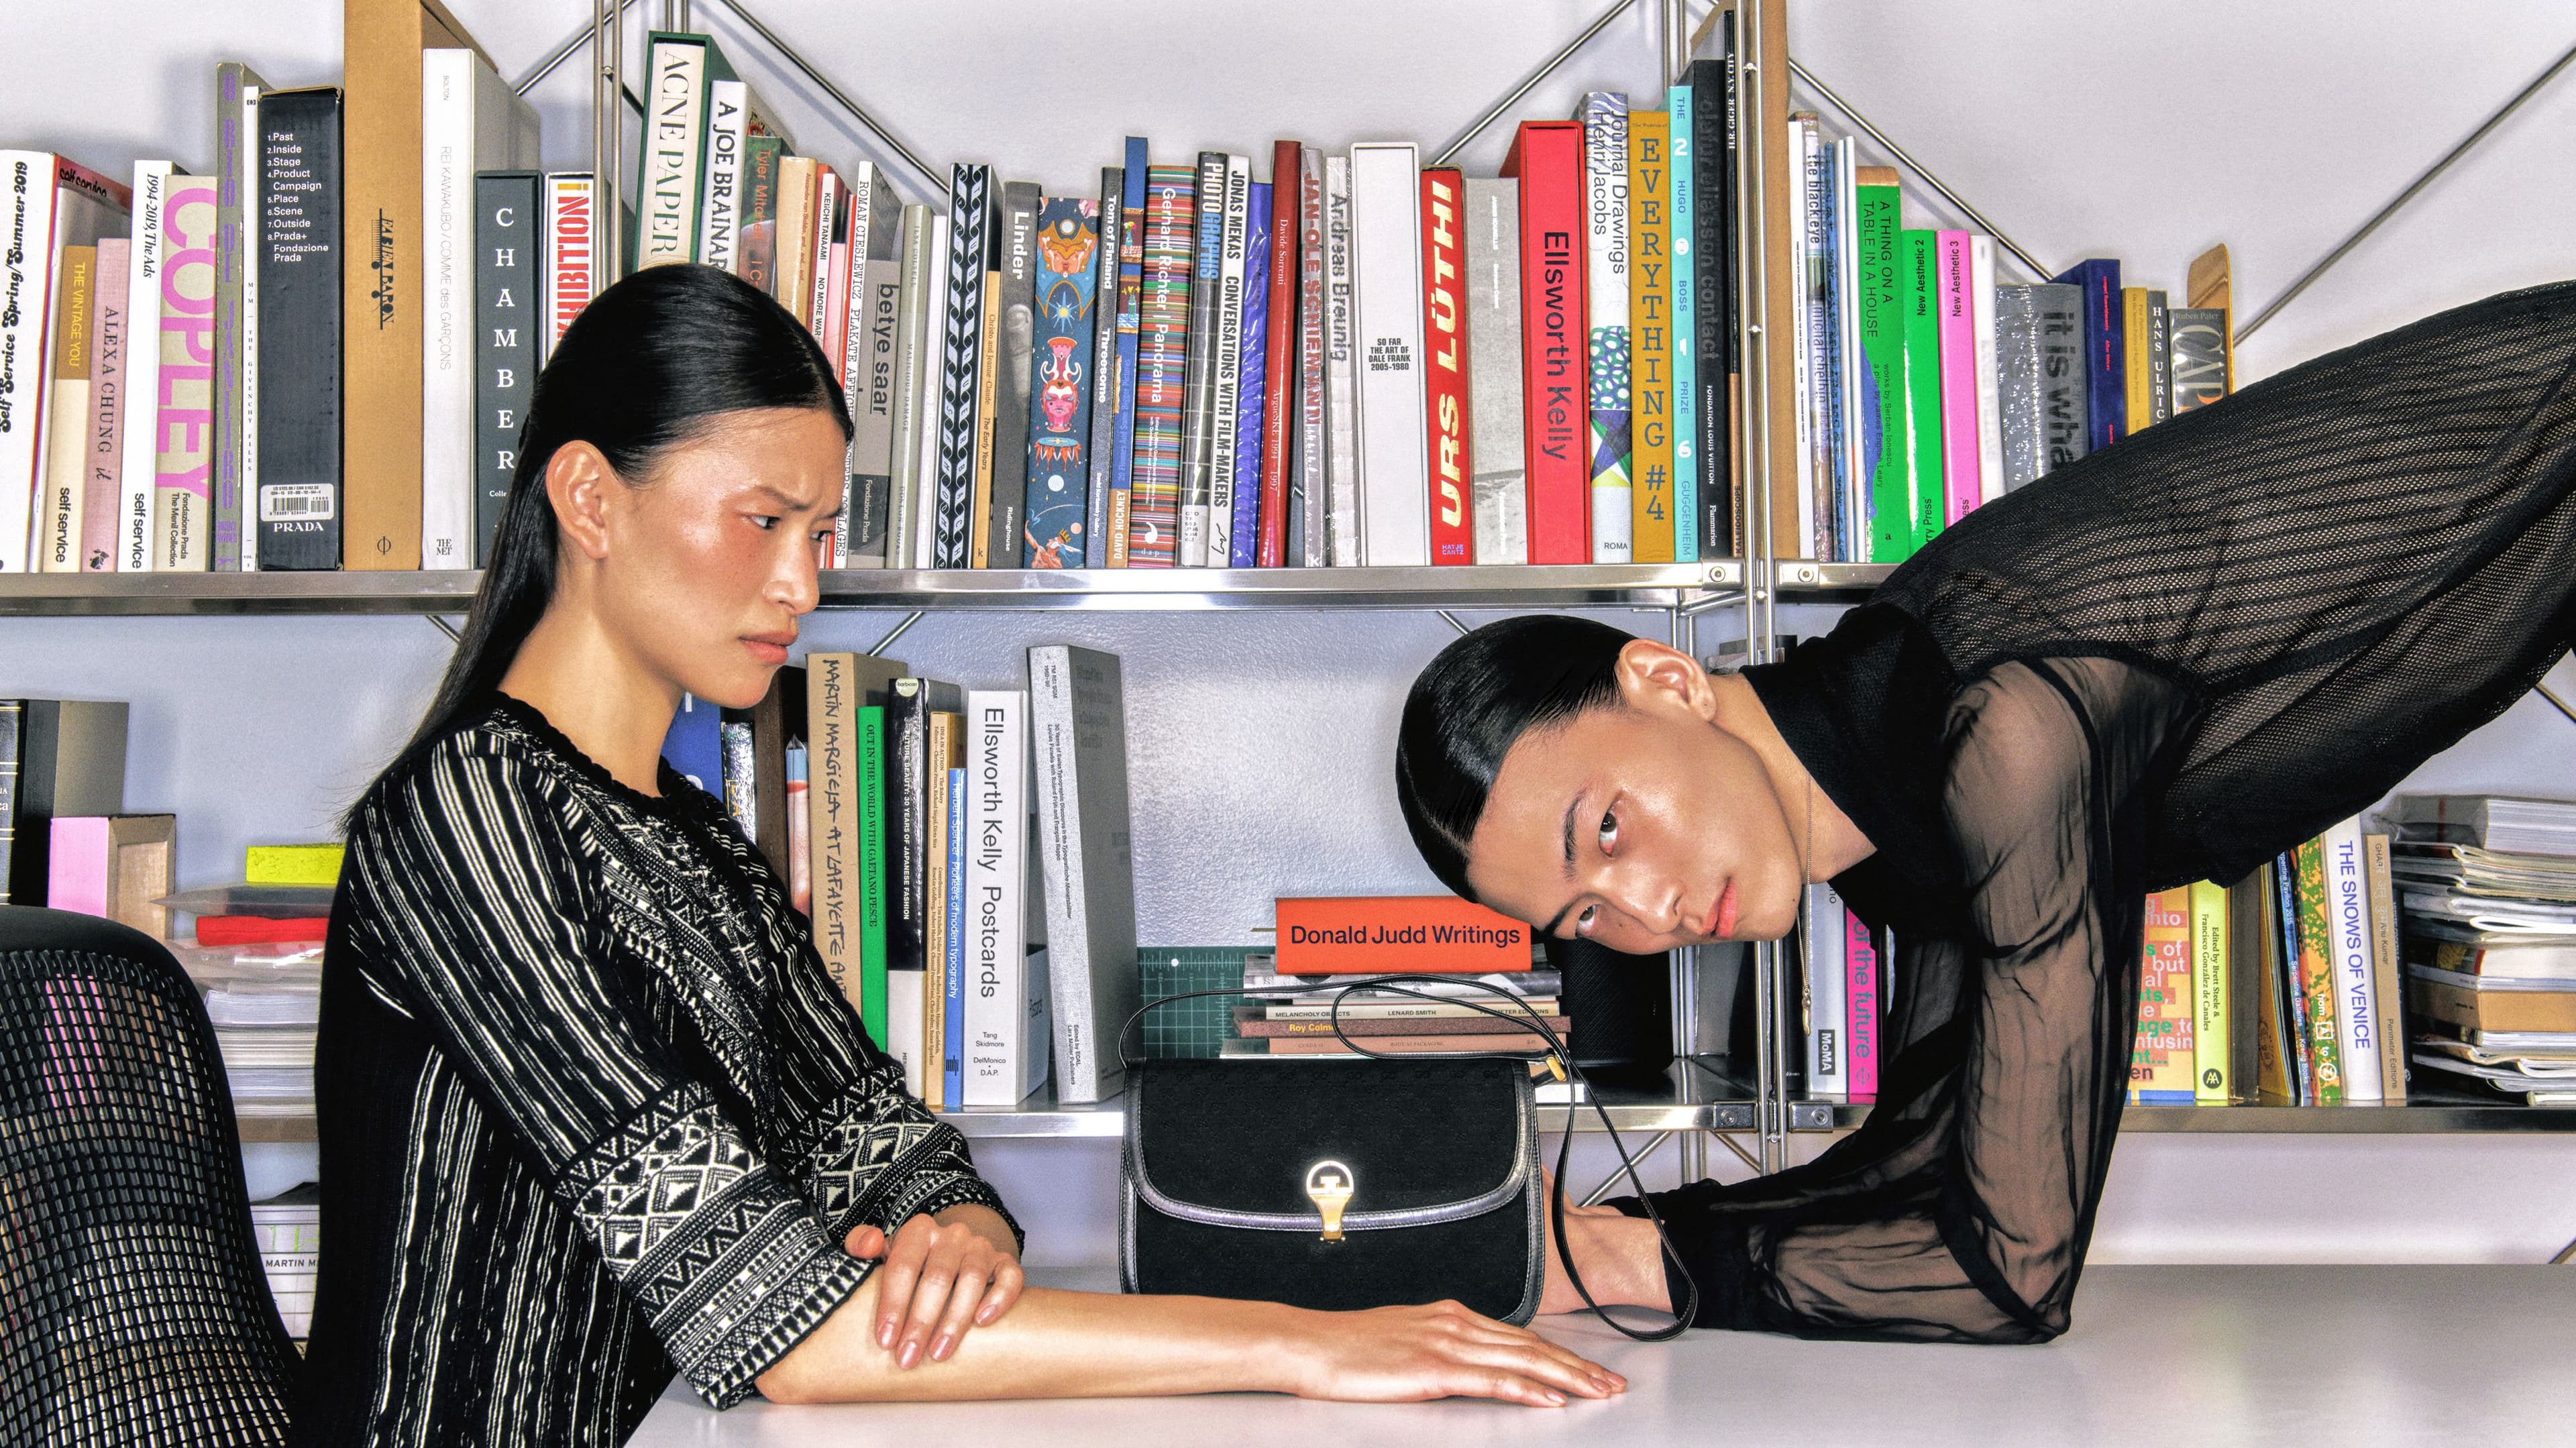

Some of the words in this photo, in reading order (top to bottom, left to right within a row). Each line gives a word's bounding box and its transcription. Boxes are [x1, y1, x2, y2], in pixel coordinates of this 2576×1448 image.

[660, 50, 690, 140] ACNE
[718, 101, 738, 118] A
[712, 123, 736, 166] JOE
[1593, 111, 1611, 162] Henri
[1611, 110, 1627, 178] Journal
[1807, 154, 1821, 176] the
[142, 173, 159, 231] 1994-2019,
[273, 182, 322, 191] Campaign
[651, 148, 684, 254] PAPER
[1230, 170, 1246, 213] JONAS
[1593, 168, 1611, 235] Jacobs
[1808, 180, 1821, 216] black
[708, 172, 733, 270] BRAINAR
[1107, 194, 1117, 224] Tom
[1159, 188, 1176, 251] Gerhard
[1199, 162, 1224, 280] PHOTOGRAPHIS
[1864, 201, 1876, 246] TABLE
[1880, 201, 1891, 211] A
[144, 233, 157, 255] The
[1012, 211, 1030, 280] Linder
[1106, 225, 1116, 241] of
[1226, 215, 1243, 260] MEKAS
[1279, 219, 1289, 249] Davide
[1608, 184, 1628, 274] Drawings
[1807, 220, 1821, 243] eye
[1880, 216, 1892, 261] THING
[274, 244, 329, 252] Fondazione
[274, 254, 302, 262] Prada
[1104, 242, 1114, 289] Finland
[1865, 252, 1876, 266] IN
[73, 262, 85, 287] THE
[143, 255, 156, 278] Ads
[818, 277, 825, 290] NO
[1155, 255, 1173, 312] Richter
[1278, 250, 1287, 286] Sorrenti
[1430, 180, 1457, 373] LÜTHI
[1866, 272, 1876, 281] A
[1882, 267, 1893, 288] ON
[1915, 248, 1926, 292] Aesthetic
[1951, 249, 1960, 293] Aesthetic
[816, 292, 824, 316] MORE
[1544, 232, 1571, 377] Ellsworth
[1640, 138, 1666, 448] EVERYTHING
[1882, 294, 1893, 303] A
[1917, 295, 1926, 316] New
[1952, 296, 1962, 317] New
[70, 289, 83, 339] VINTAGE
[814, 317, 822, 336] WAR
[872, 284, 899, 353] betye
[987, 314, 996, 338] Christo
[1220, 276, 1240, 380] CONVERSATIONS
[1866, 287, 1878, 338] HOUSE
[68, 341, 82, 367] YOU
[102, 306, 118, 376] ALEXA
[155, 188, 217, 500] COPLEY
[494, 207, 518, 469] CHAMBER
[1370, 346, 1383, 354] THE
[1385, 346, 1399, 354] ART
[1400, 346, 1409, 354] OF
[904, 343, 913, 392] MALICIOUS
[984, 355, 994, 405] Jeanne-Claude
[1099, 328, 1111, 403] Threesome
[1151, 323, 1169, 403] Panorama
[1371, 363, 1409, 371] 2005-1980
[872, 361, 890, 415] saar
[1218, 383, 1235, 416] WITH
[97, 382, 115, 453] CHUNG
[902, 396, 910, 432] DAMAGE
[1542, 386, 1573, 461] Kelly
[981, 431, 990, 449] Early
[981, 451, 989, 470] Years
[1214, 419, 1232, 508] FILM-MAKERS
[1438, 394, 1462, 527] URS
[59, 487, 71, 512] self
[134, 493, 146, 517] self
[171, 492, 180, 508] The
[180, 493, 191, 536] Fondazione
[863, 480, 873, 520] Fondazione
[1115, 490, 1126, 531] HOCKNEY
[170, 508, 179, 528] Menil
[274, 522, 324, 532] PRADA
[862, 521, 871, 543] Prada
[1005, 506, 1014, 551] Ridinghouse
[1709, 504, 1717, 547] Flammarion
[1733, 485, 1743, 554] KALEIDOSCOPE
[56, 512, 69, 563] service
[132, 518, 145, 569] service
[169, 530, 178, 567] Collection
[180, 537, 189, 559] Prada
[1114, 532, 1124, 559] DAVID
[866, 724, 875, 746] OUT
[867, 746, 875, 757] IN
[867, 759, 875, 781] THE
[984, 708, 1004, 812] Ellsworth
[867, 783, 876, 818] WORLD
[903, 796, 910, 805] 30
[868, 820, 877, 846] WITH
[903, 834, 910, 844] OF
[977, 820, 1003, 871] Kelly
[868, 848, 877, 896] GAETANO
[2339, 840, 2356, 876] THE
[869, 896, 877, 927] PESCE
[2341, 880, 2361, 950] SNOWS
[981, 886, 1002, 998] Postcards
[1291, 926, 1367, 944] Donald
[1372, 926, 1426, 944] Judd
[1432, 926, 1521, 948] Writings
[2163, 940, 2182, 956] of
[2202, 913, 2210, 950] Francisco
[1854, 948, 1873, 986] the
[2152, 955, 2185, 972] but
[2202, 951, 2211, 989] González
[2210, 953, 2219, 963] by
[2347, 954, 2365, 979] OF
[2203, 989, 2210, 999] de
[2290, 960, 2300, 996] Serpentine
[1855, 991, 1874, 1058] future
[2203, 1001, 2211, 1032] Canales
[2294, 997, 2303, 1027] Galleries
[2351, 983, 2370, 1049] VENICE
[1821, 1032, 1832, 1072] MoMA
[2299, 1038, 2308, 1062] Koenig
[2302, 1062, 2310, 1084] Books
[265, 1259, 305, 1267] MARTIN
